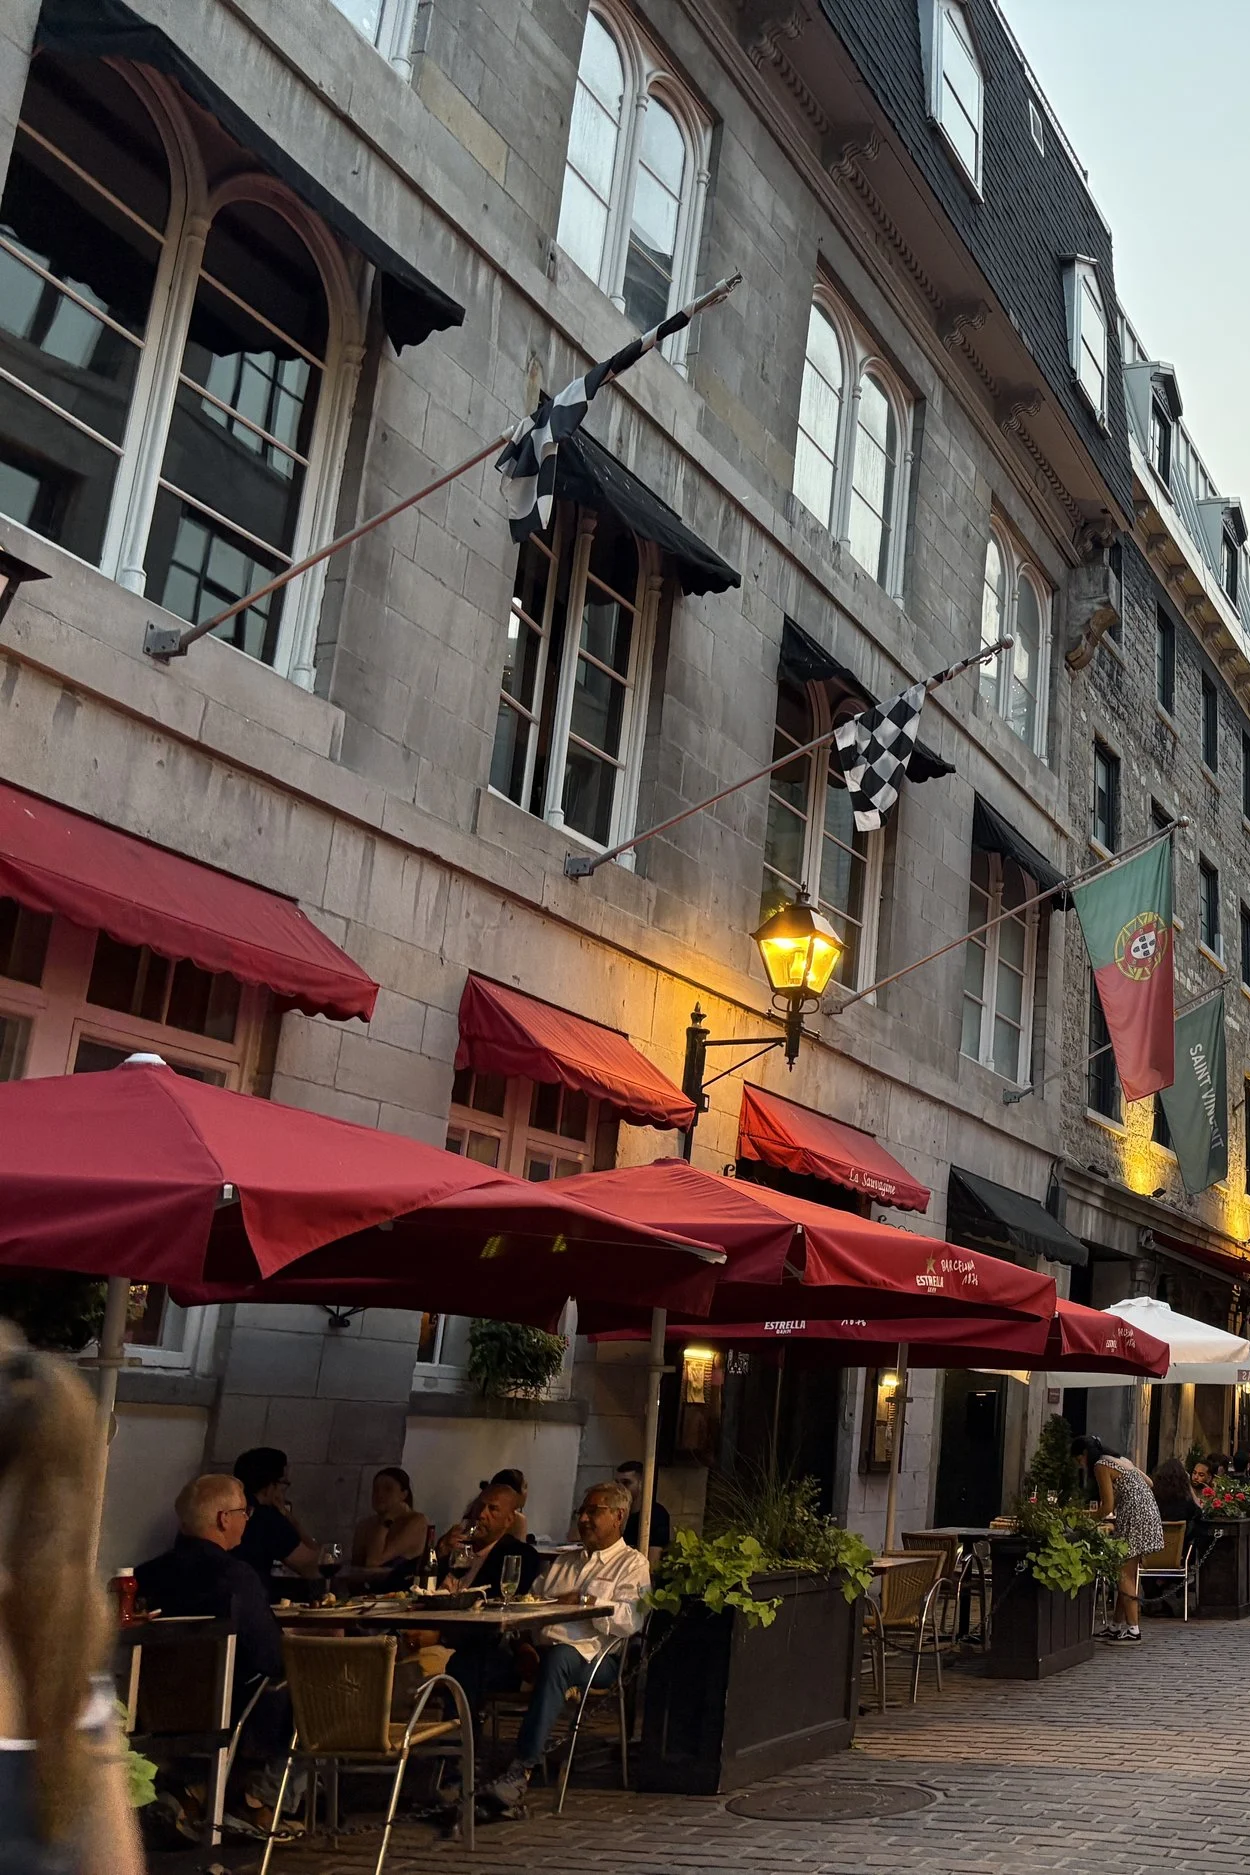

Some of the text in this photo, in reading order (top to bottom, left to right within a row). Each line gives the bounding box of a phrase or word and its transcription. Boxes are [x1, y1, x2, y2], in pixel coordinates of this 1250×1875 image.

[1189, 1043, 1212, 1087] SAINT
[849, 1168, 896, 1197] La Sauvagine
[764, 1320, 806, 1330] ESTRELLA
